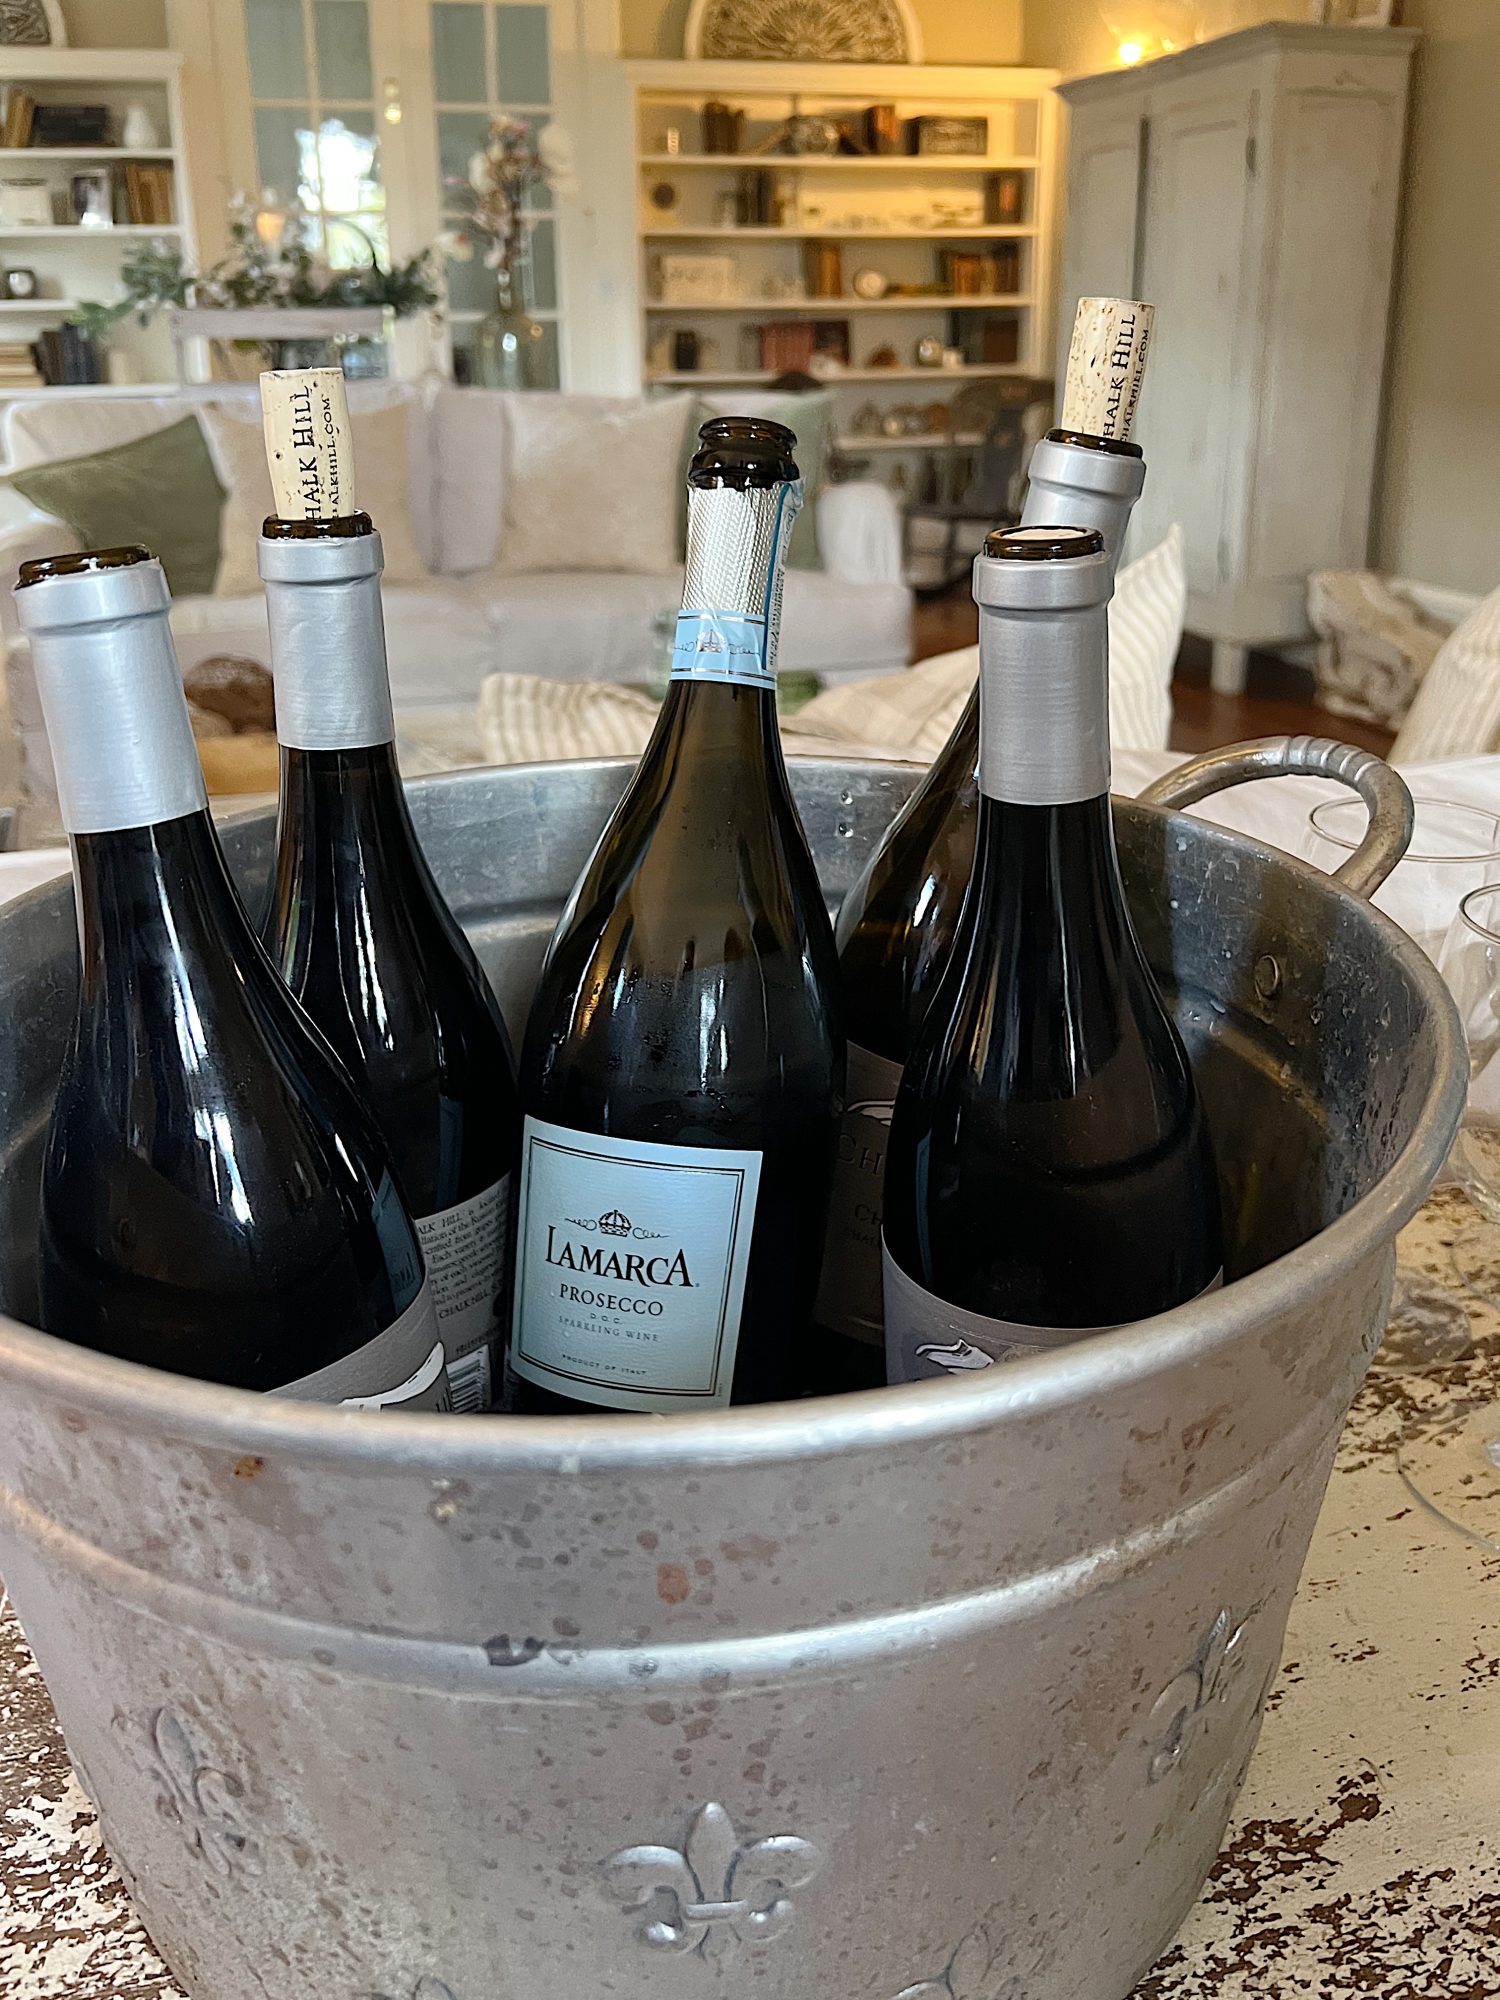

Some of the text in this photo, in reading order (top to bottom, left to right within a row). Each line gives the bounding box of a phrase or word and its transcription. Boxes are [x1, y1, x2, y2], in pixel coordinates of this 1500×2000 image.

[1103, 314, 1136, 438] HALK HILL
[292, 385, 321, 521] HALK HILL
[559, 1283, 664, 1316] PROSECCO
[559, 1315, 660, 1343] SPARKLING WINE
[562, 1353, 600, 1369] PRODUCT
